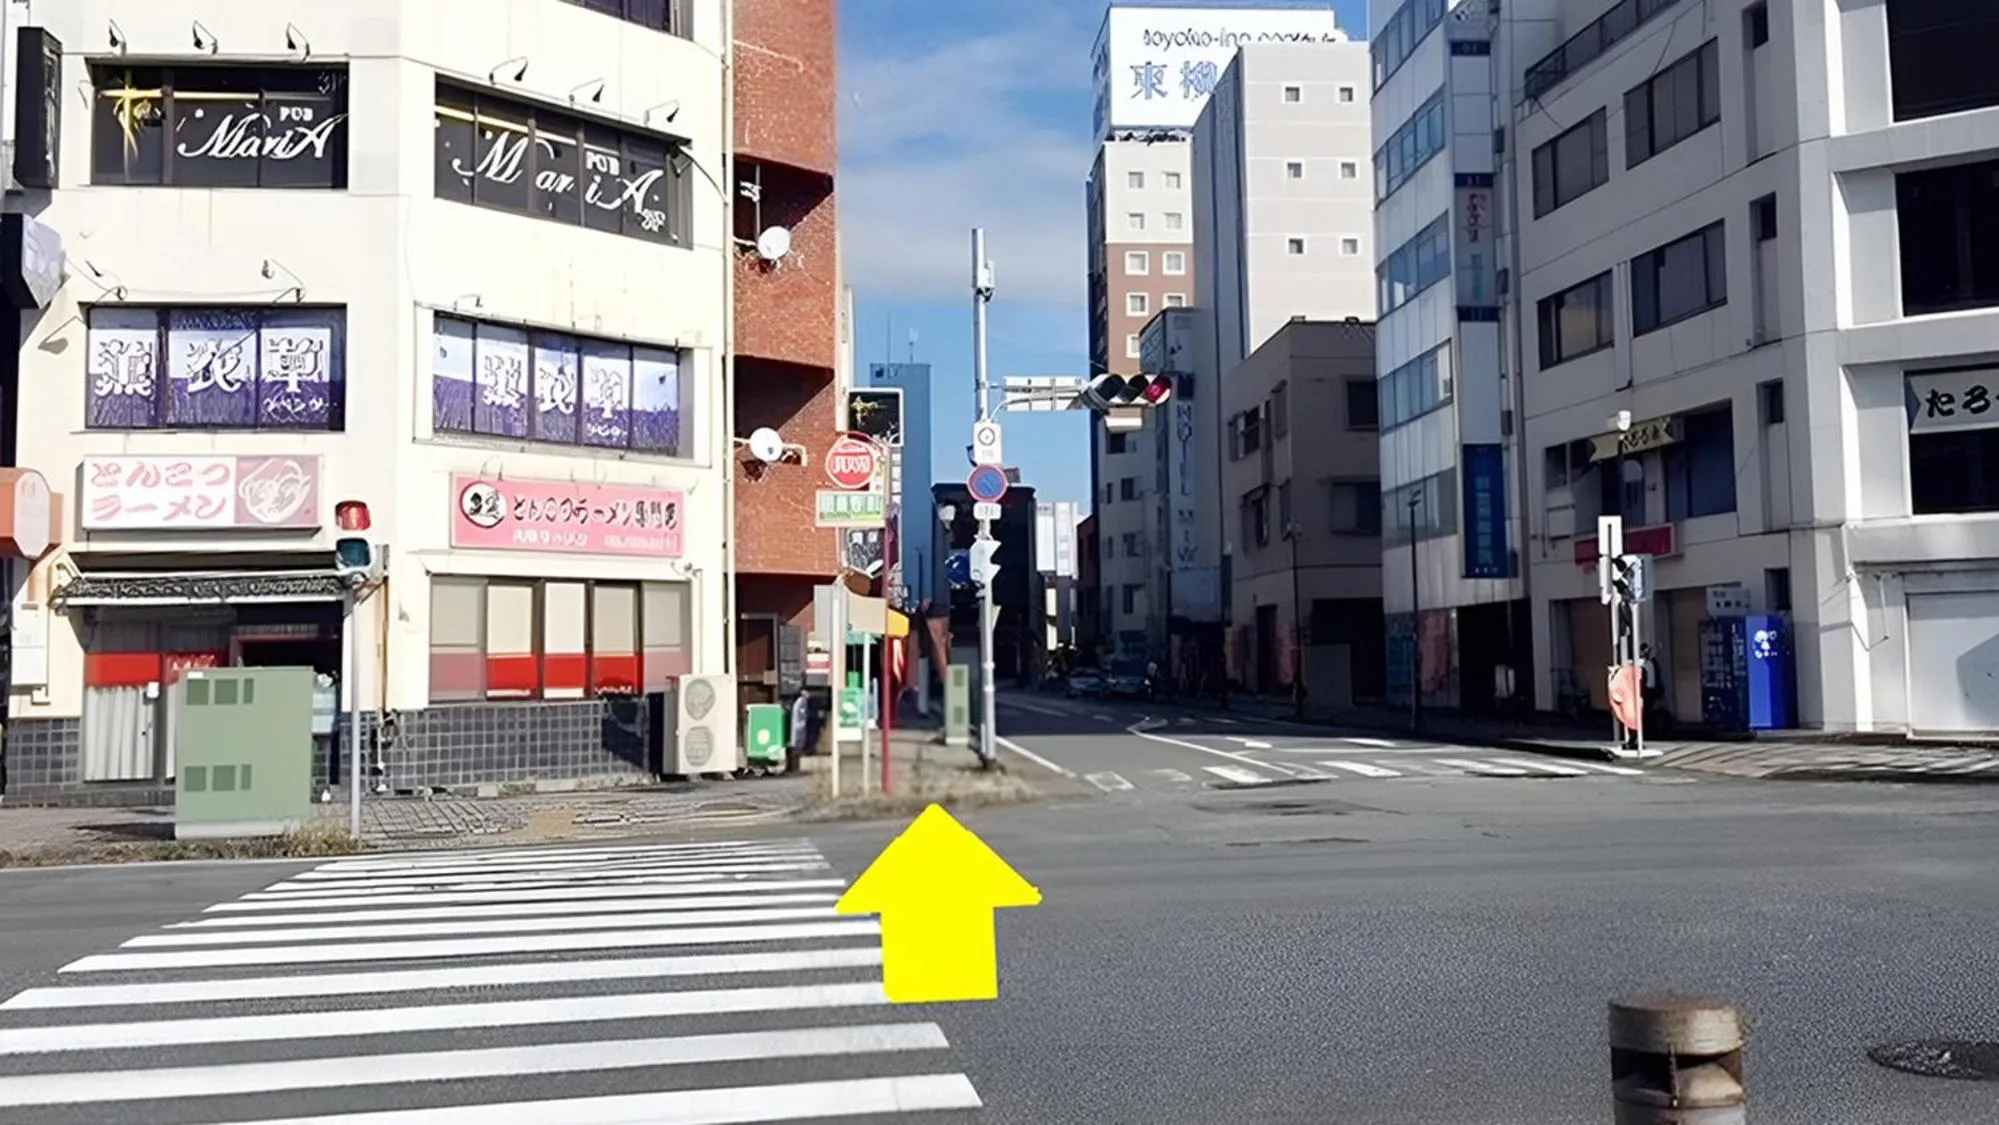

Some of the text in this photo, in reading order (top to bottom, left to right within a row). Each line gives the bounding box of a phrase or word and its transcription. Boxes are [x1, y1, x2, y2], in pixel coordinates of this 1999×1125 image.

[91, 461, 231, 488] とんこつ
[91, 494, 226, 521] ラーメン
